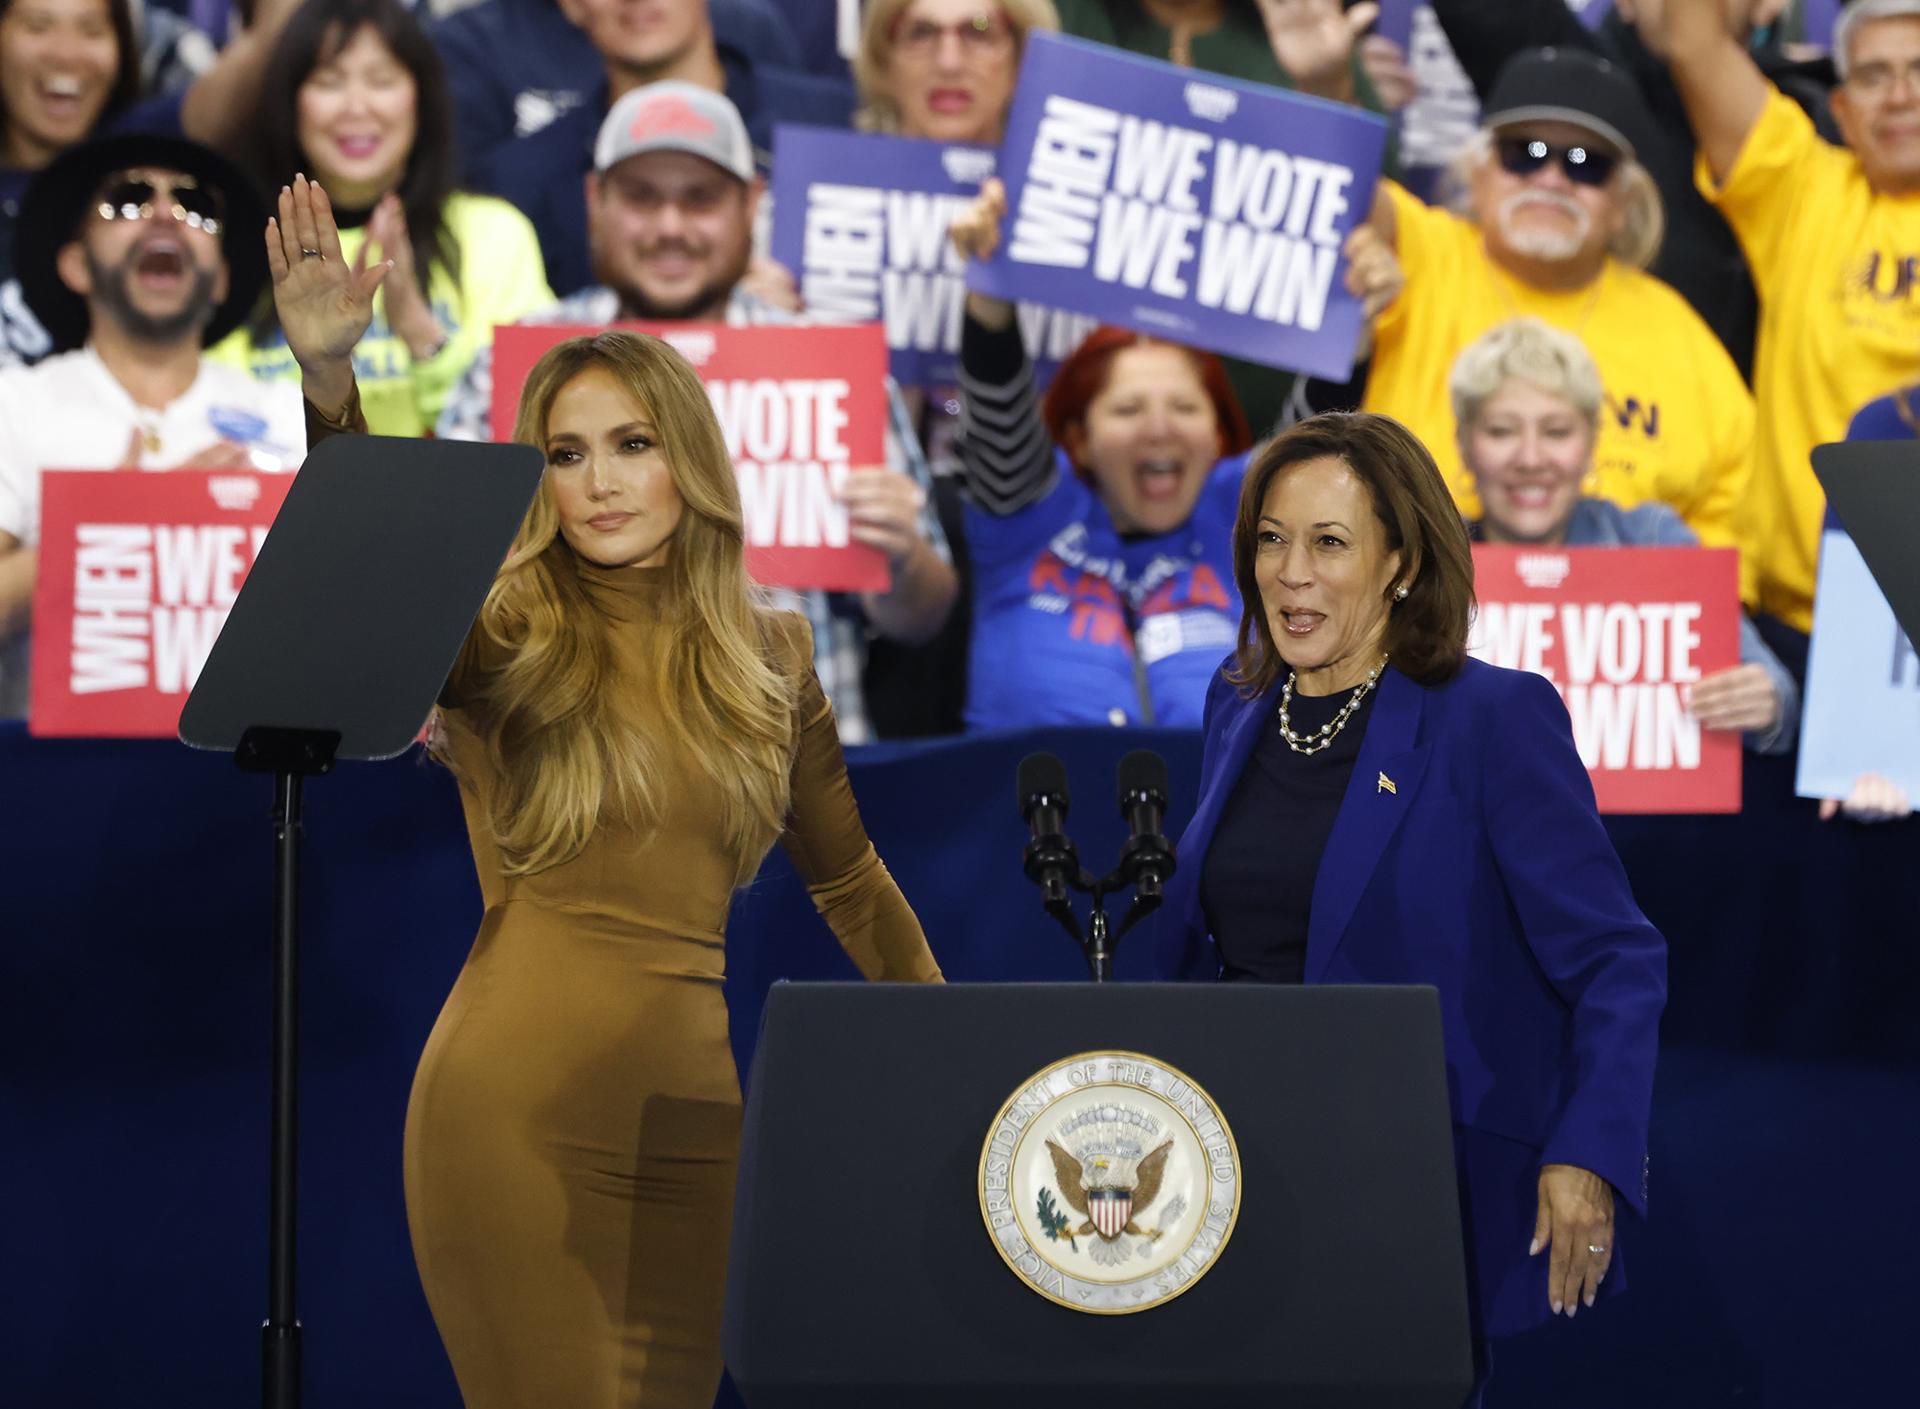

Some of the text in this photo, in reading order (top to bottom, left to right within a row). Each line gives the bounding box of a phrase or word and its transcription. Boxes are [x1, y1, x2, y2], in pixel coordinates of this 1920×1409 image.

[1008, 94, 1121, 268] WHEN
[1113, 114, 1354, 248] WE VOTE
[1093, 191, 1205, 300] WE
[1195, 218, 1338, 332] WIN
[708, 379, 850, 462] VOTE
[70, 523, 151, 694] WHEN
[153, 525, 247, 605] WE
[153, 606, 230, 694] W
[1467, 601, 1702, 684] WE VOTE
[1568, 683, 1701, 770] WIN
[1067, 1064, 1096, 1087] OF
[1108, 1063, 1154, 1087] THE
[985, 1077, 1057, 1228] PRESIDENT
[1165, 1078, 1235, 1184] UNITED
[1005, 1239, 1065, 1298] VICE
[1155, 1200, 1233, 1295] STATES
